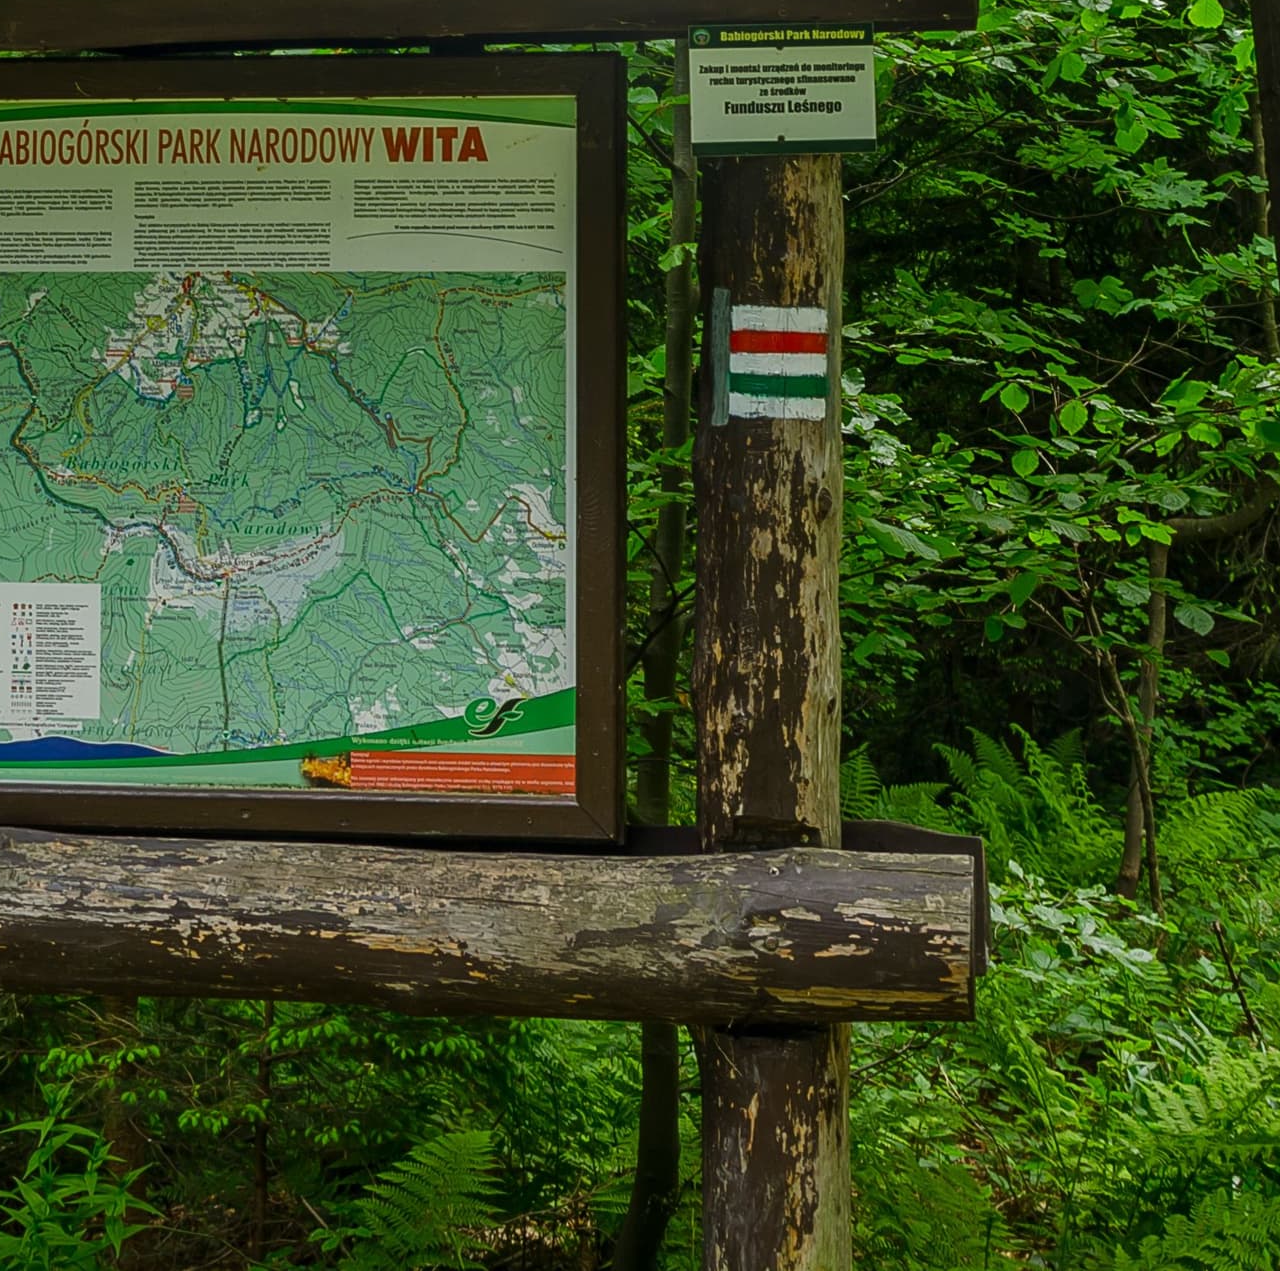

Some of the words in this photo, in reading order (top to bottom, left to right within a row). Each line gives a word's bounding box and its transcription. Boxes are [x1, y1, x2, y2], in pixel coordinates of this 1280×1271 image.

[720, 30, 785, 43] Babiogórski
[786, 30, 811, 41] Park
[812, 29, 866, 41] Narodowy
[699, 64, 725, 75] Zakup
[801, 63, 812, 72] do
[813, 62, 866, 73] monitoringu
[709, 77, 735, 86] ruchu
[759, 88, 769, 97] ze
[770, 86, 807, 97] środków
[725, 101, 785, 115] Funduszu
[787, 99, 843, 114] Leśnego
[158, 128, 221, 165] PARK
[229, 127, 374, 164] NARODOWY
[381, 126, 489, 164] WITA
